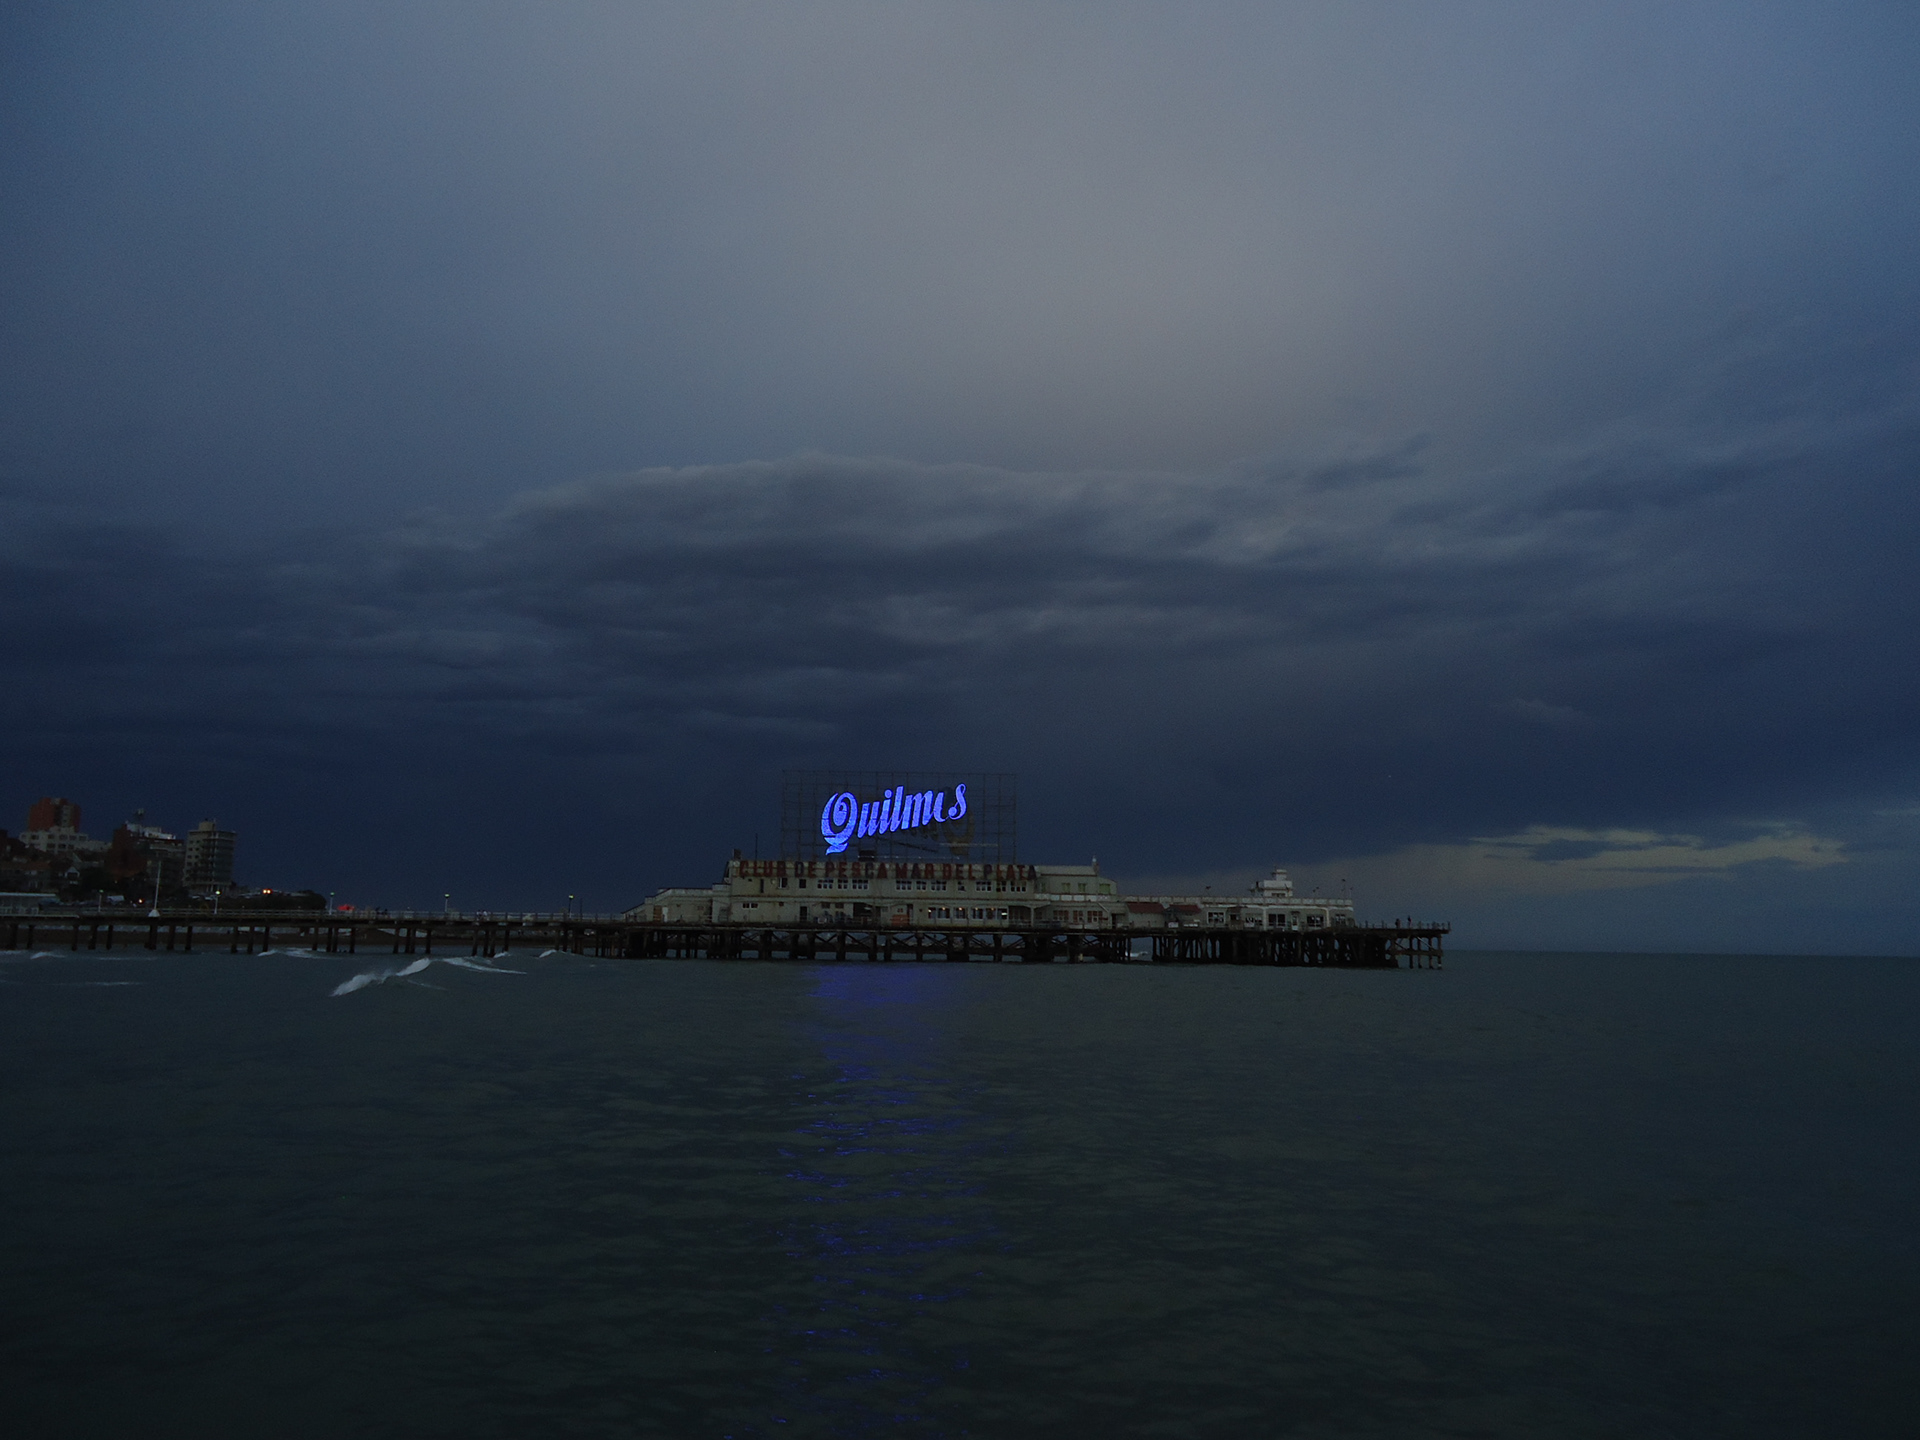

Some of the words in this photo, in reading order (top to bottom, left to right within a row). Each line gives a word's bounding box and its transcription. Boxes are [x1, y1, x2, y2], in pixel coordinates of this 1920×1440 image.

[739, 860, 787, 878] CLUB
[795, 861, 817, 878] DE
[825, 861, 888, 879] PESCA
[895, 863, 935, 880] MAR
[943, 863, 976, 880] DEL
[983, 864, 1037, 881] PLATA
